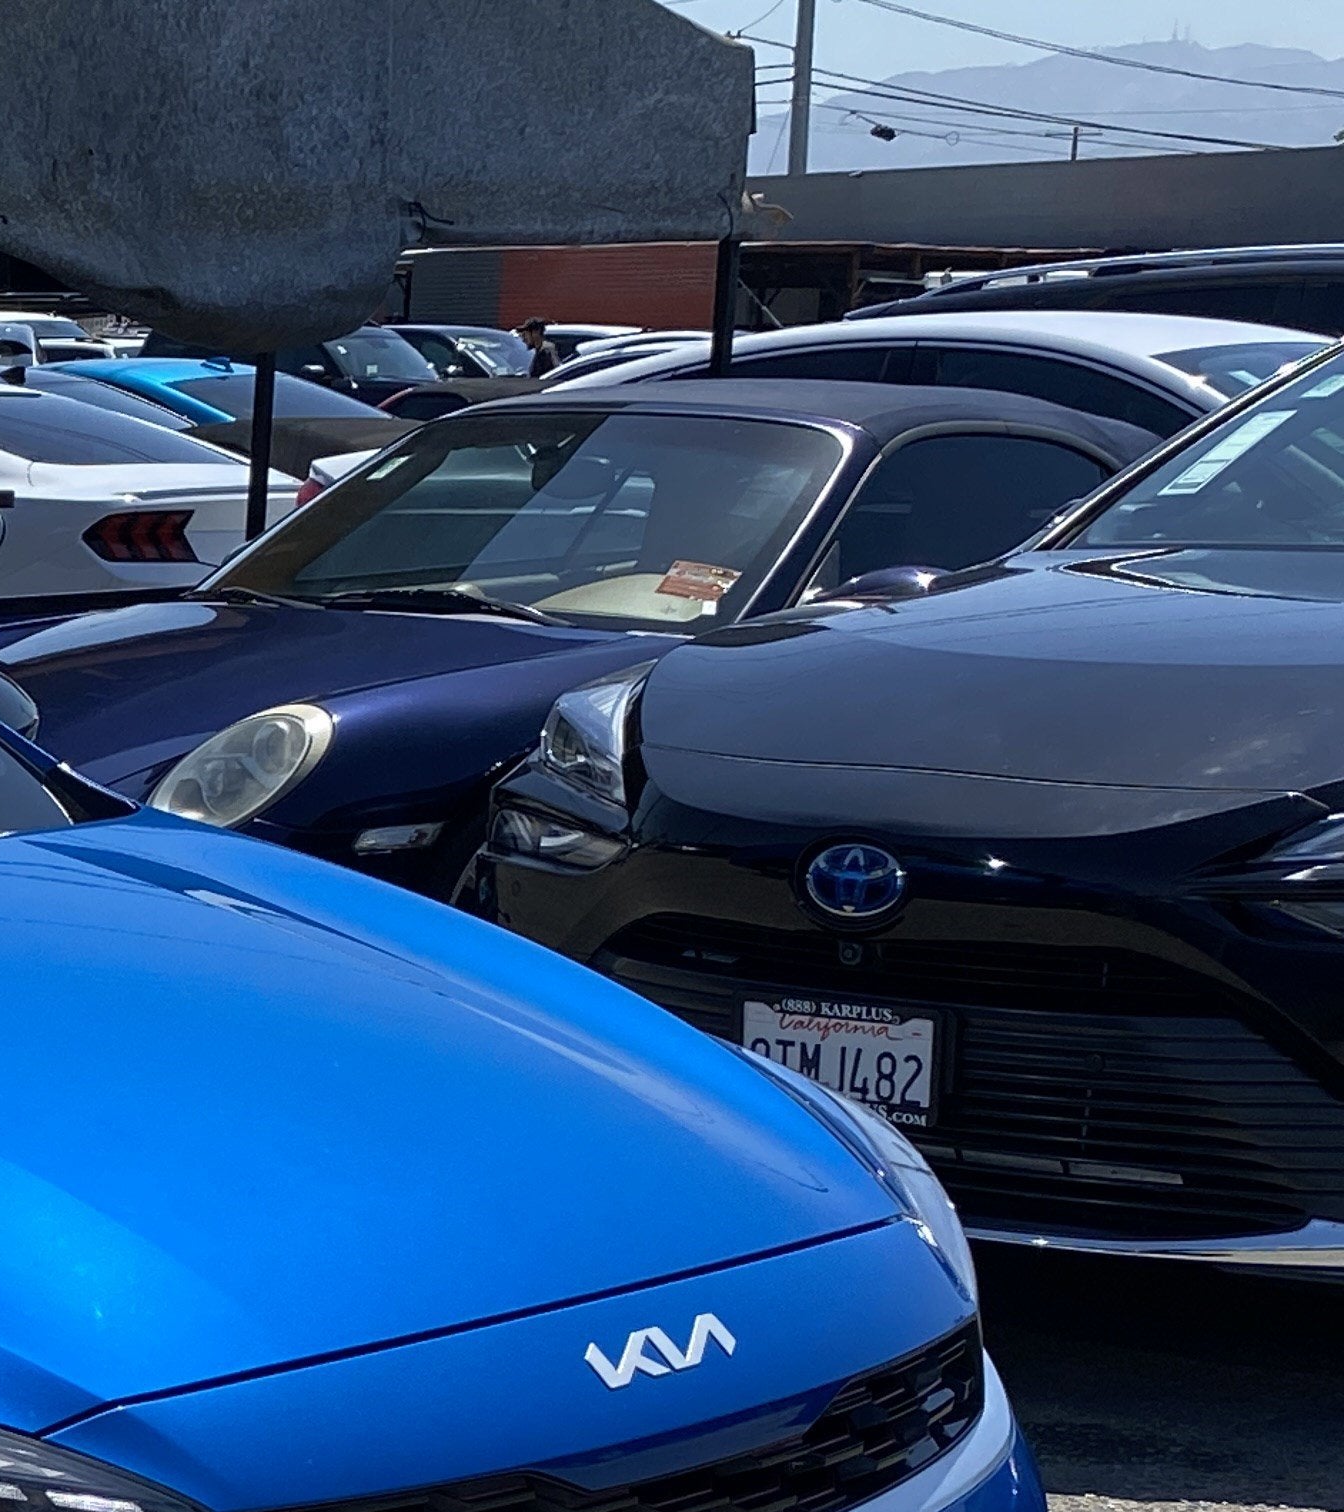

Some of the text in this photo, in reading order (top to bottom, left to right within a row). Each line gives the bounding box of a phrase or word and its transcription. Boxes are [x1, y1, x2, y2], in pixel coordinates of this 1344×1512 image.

[782, 999, 893, 1022] (888) KARPLUS
[779, 1013, 903, 1041] California
[584, 1313, 736, 1389] KIA
